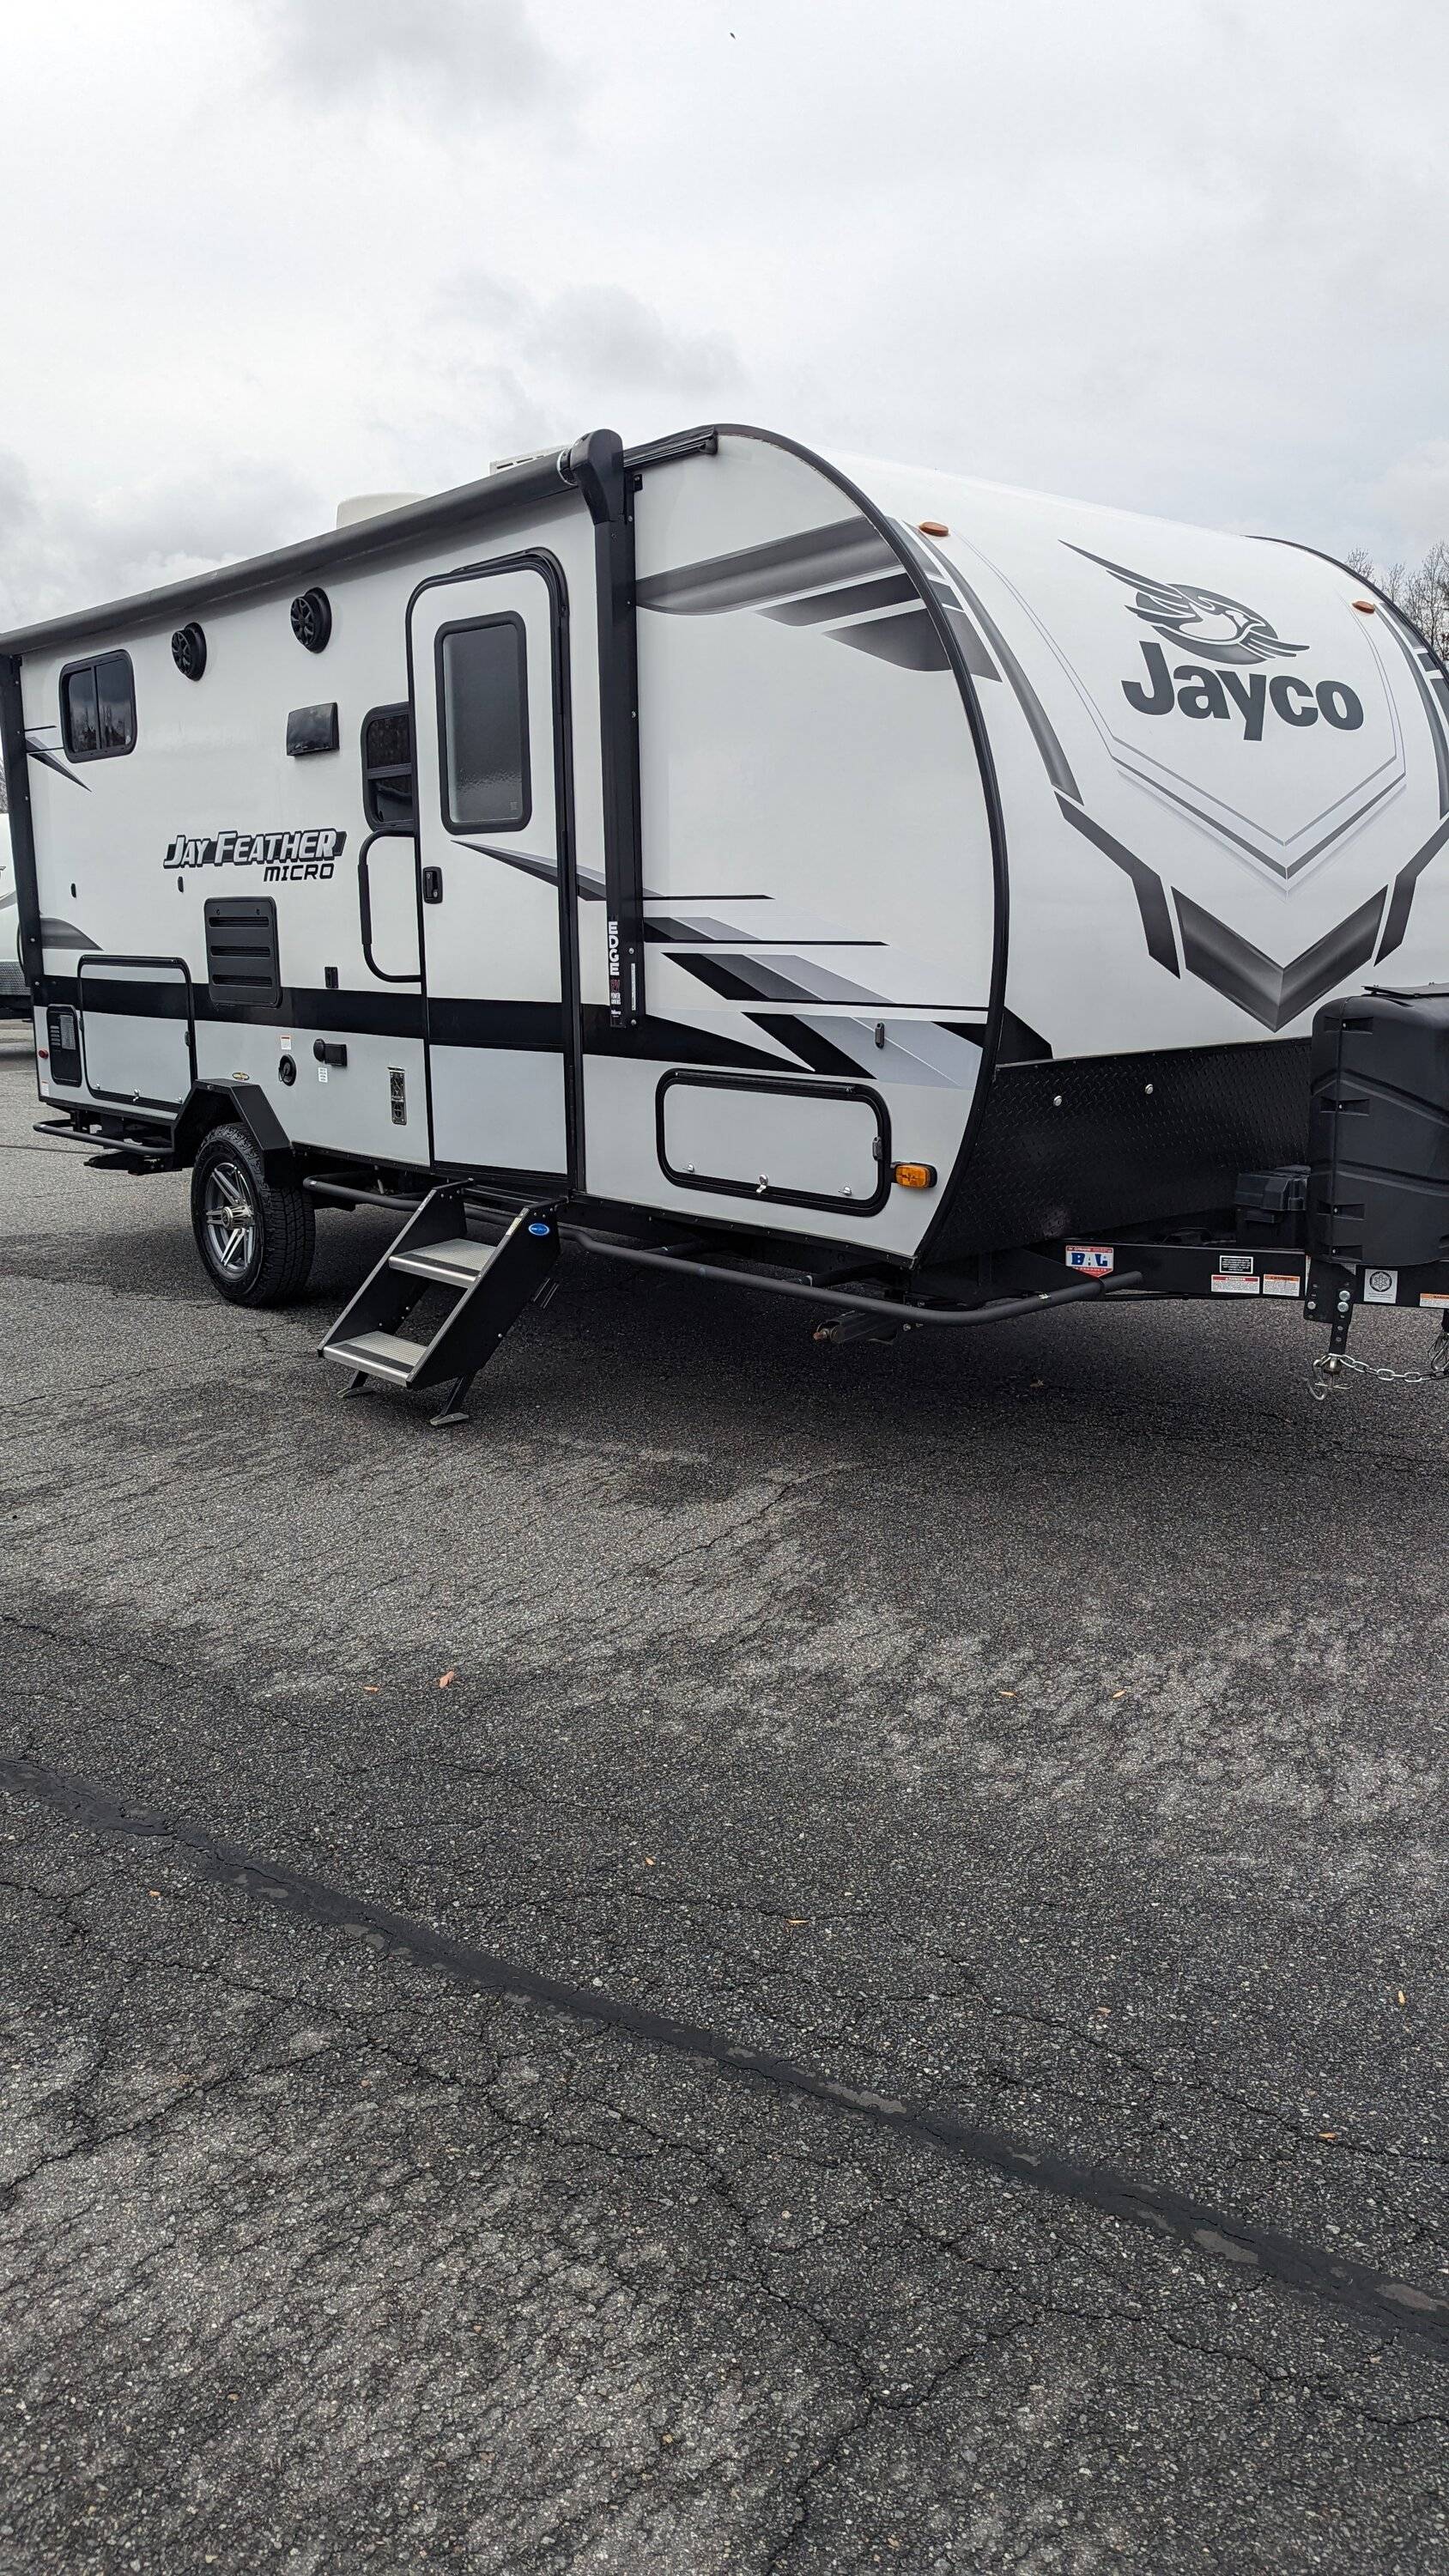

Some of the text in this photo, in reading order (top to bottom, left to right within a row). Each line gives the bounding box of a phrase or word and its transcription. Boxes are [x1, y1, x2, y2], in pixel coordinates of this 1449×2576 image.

[1120, 640, 1364, 742] Jayco
[163, 829, 337, 868] JAY FEATHER
[264, 863, 334, 882] MICRO
[609, 920, 620, 975] EDGE
[1070, 1252, 1108, 1267] BAL
